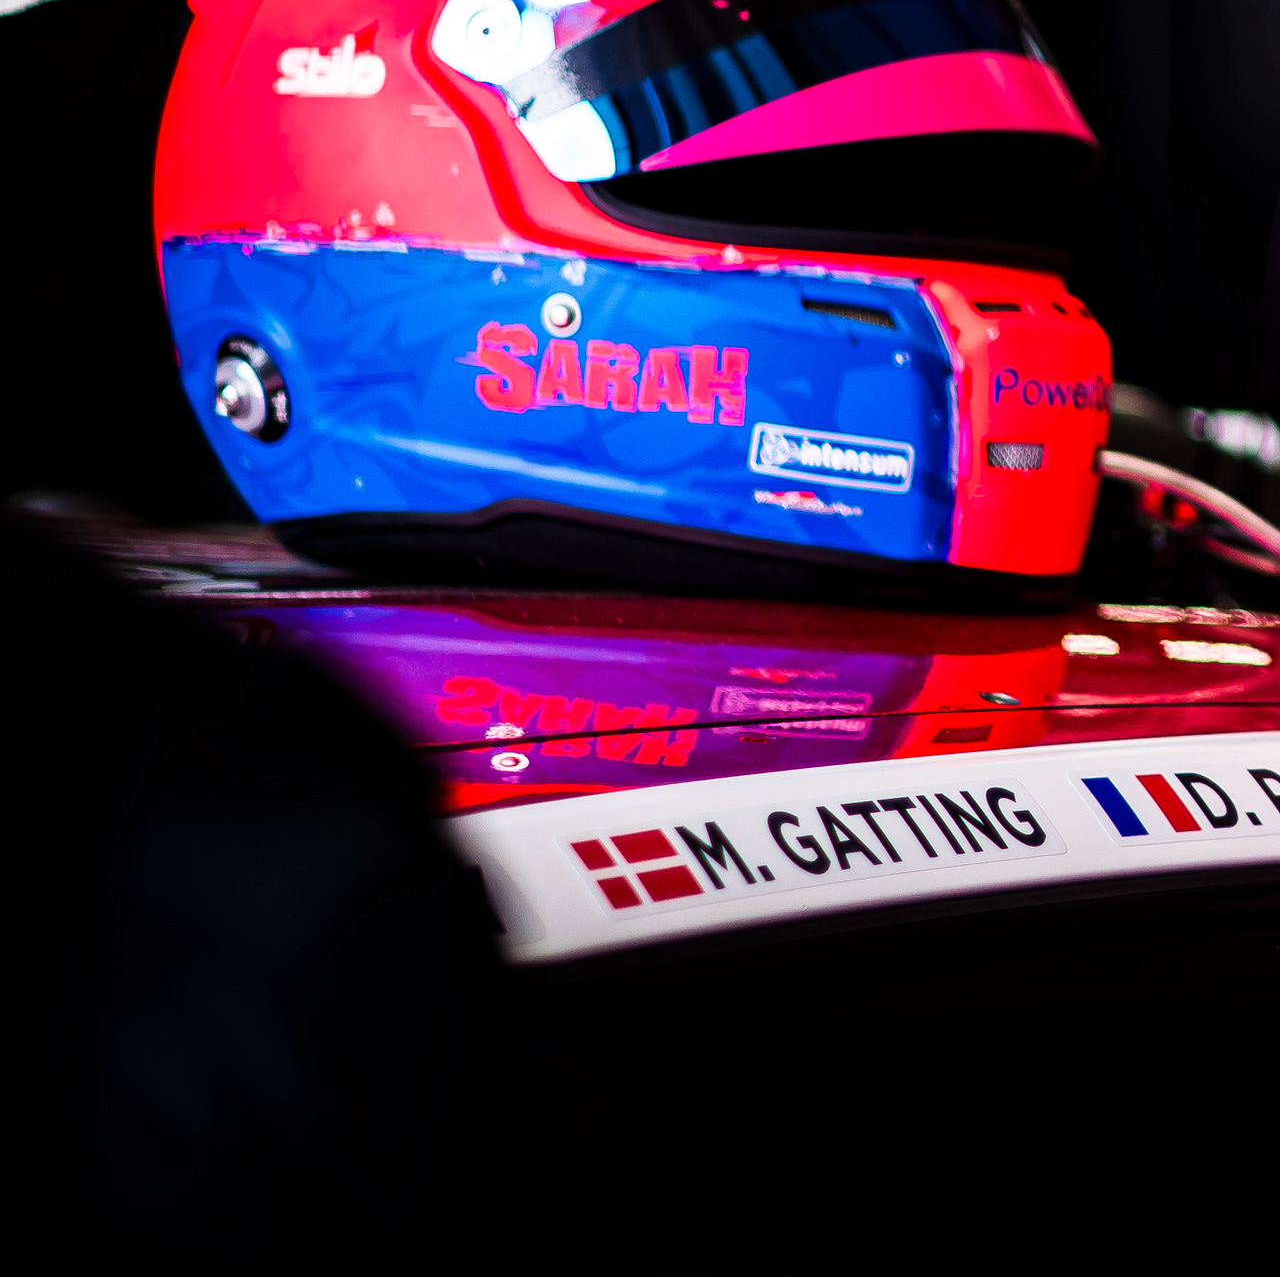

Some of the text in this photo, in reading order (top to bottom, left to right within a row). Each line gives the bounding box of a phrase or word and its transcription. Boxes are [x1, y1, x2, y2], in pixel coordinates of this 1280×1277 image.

[475, 321, 750, 426] SARAH
[675, 784, 1047, 890] M. GATTING
[1176, 771, 1257, 831] D.
